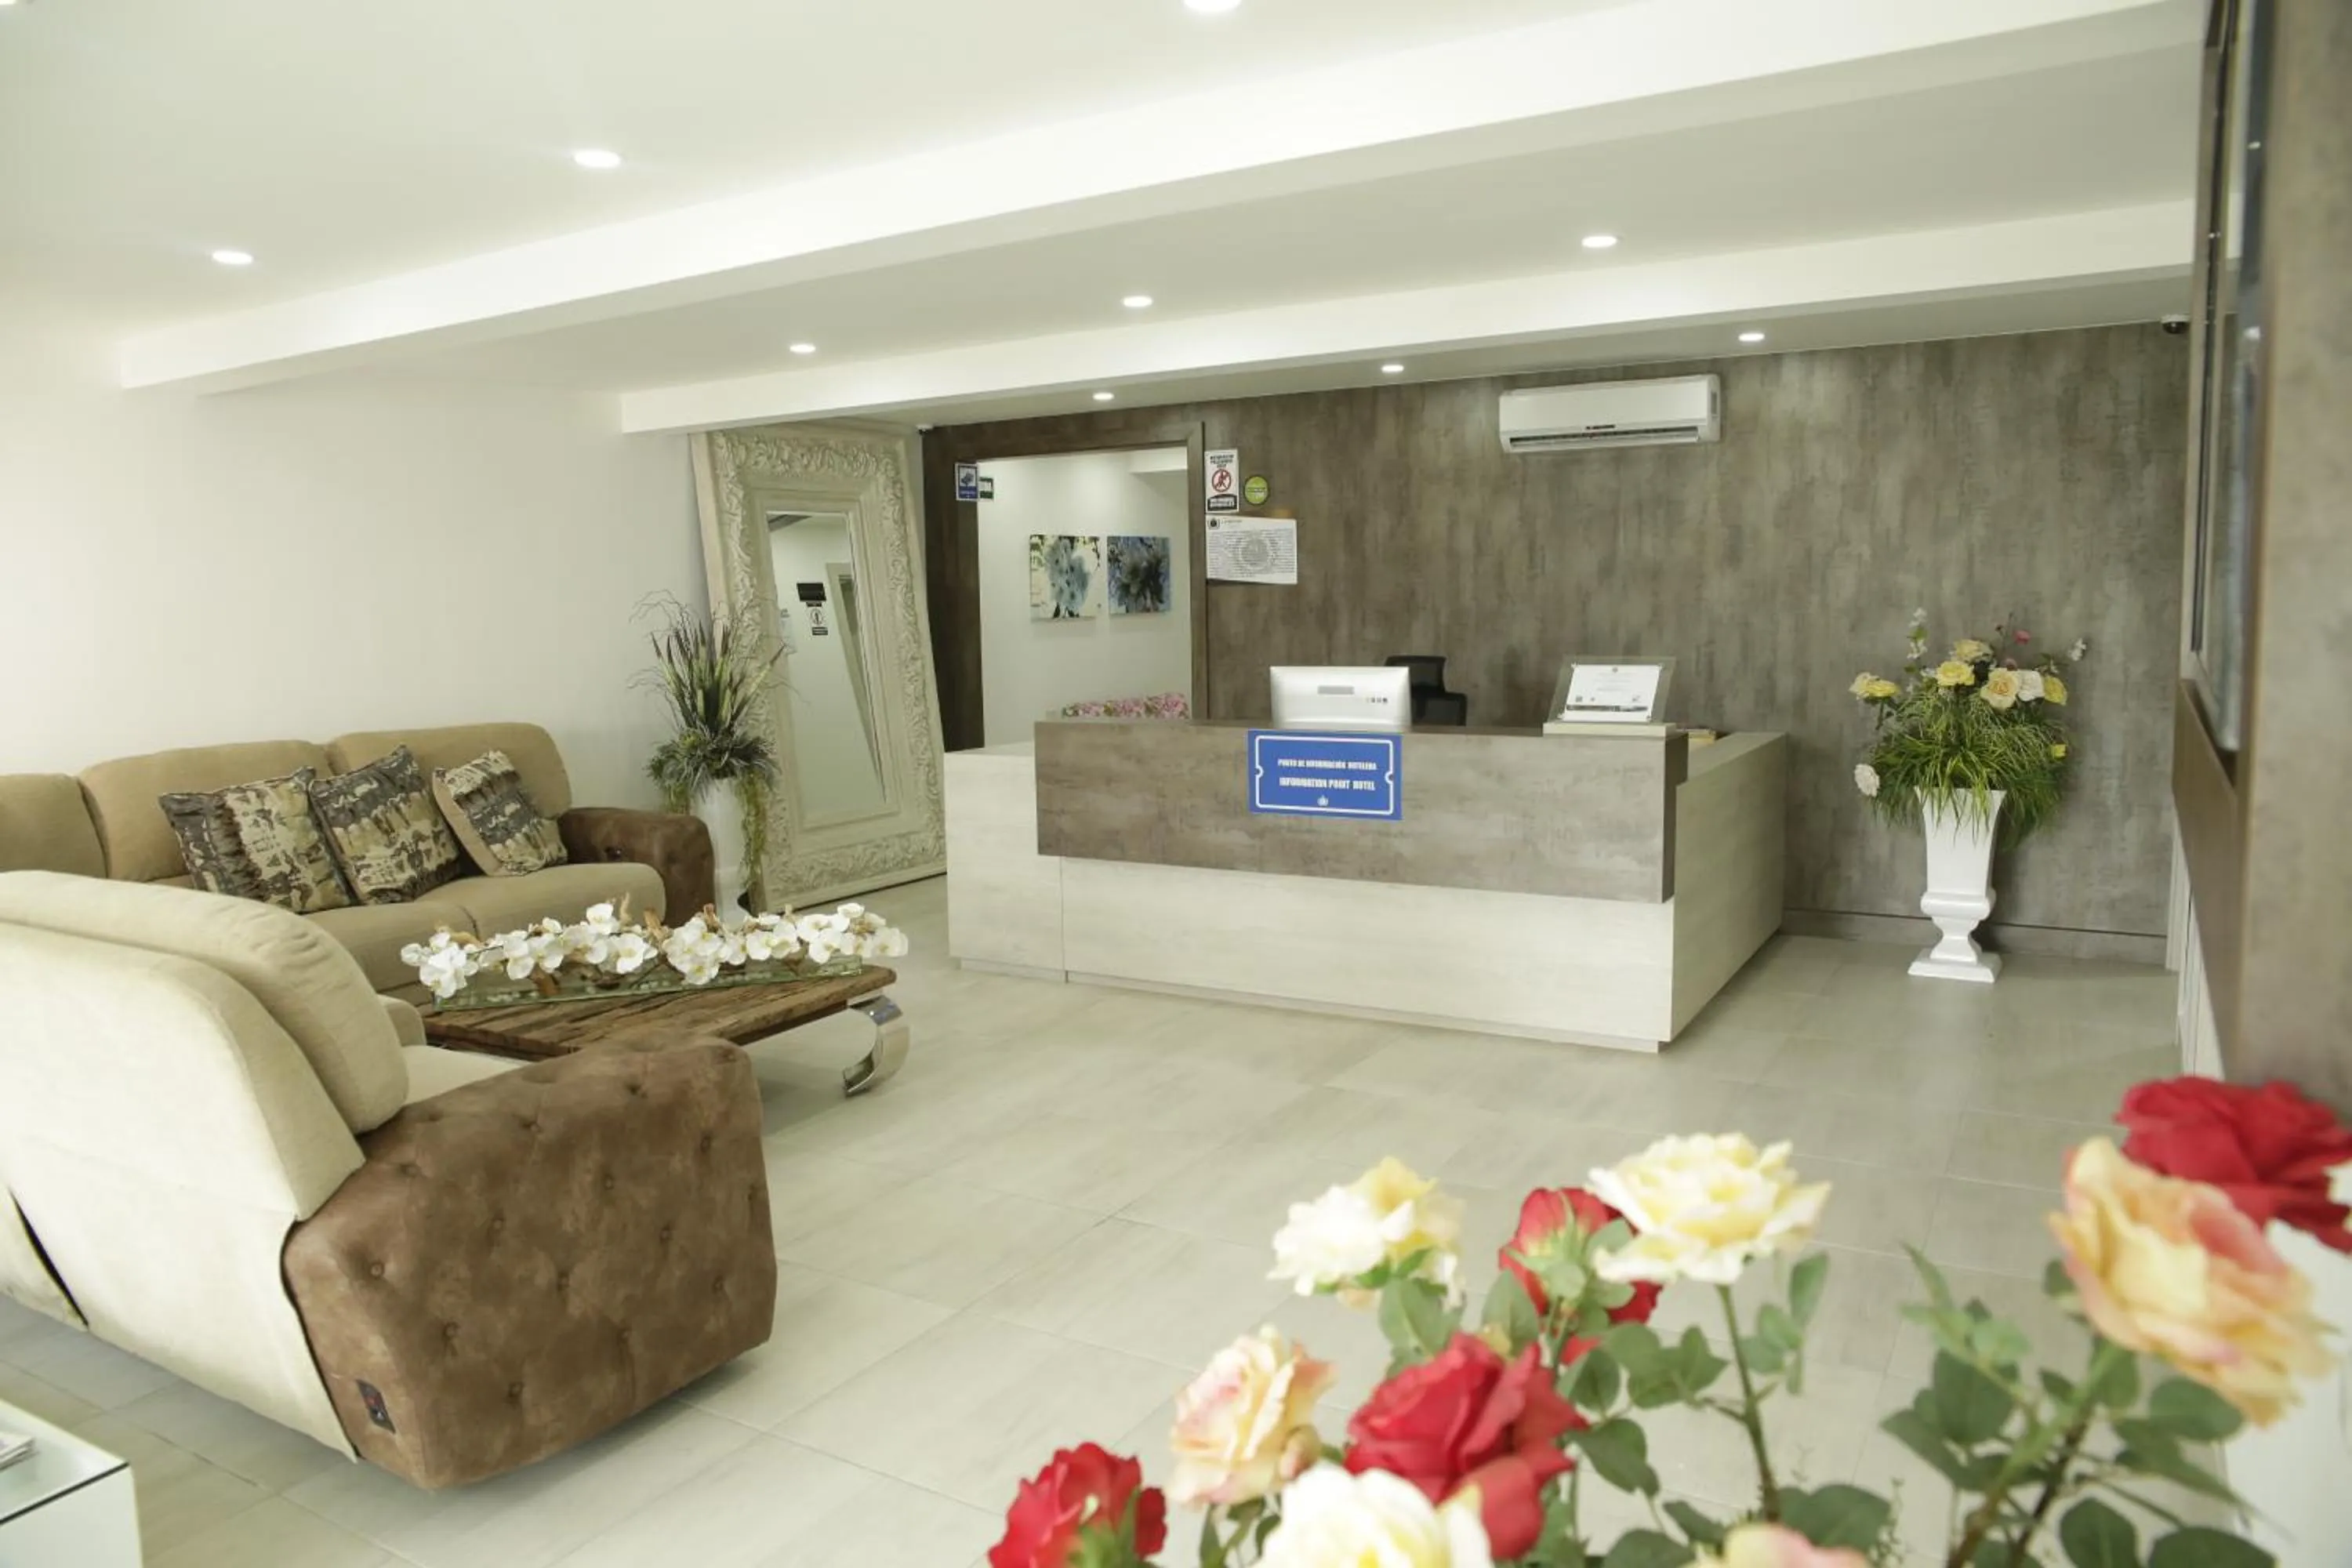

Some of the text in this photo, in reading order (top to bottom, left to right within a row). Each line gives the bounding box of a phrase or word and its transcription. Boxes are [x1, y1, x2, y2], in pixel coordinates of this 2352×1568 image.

[1279, 777, 1375, 791] INFORMATION POINT HOTEL
